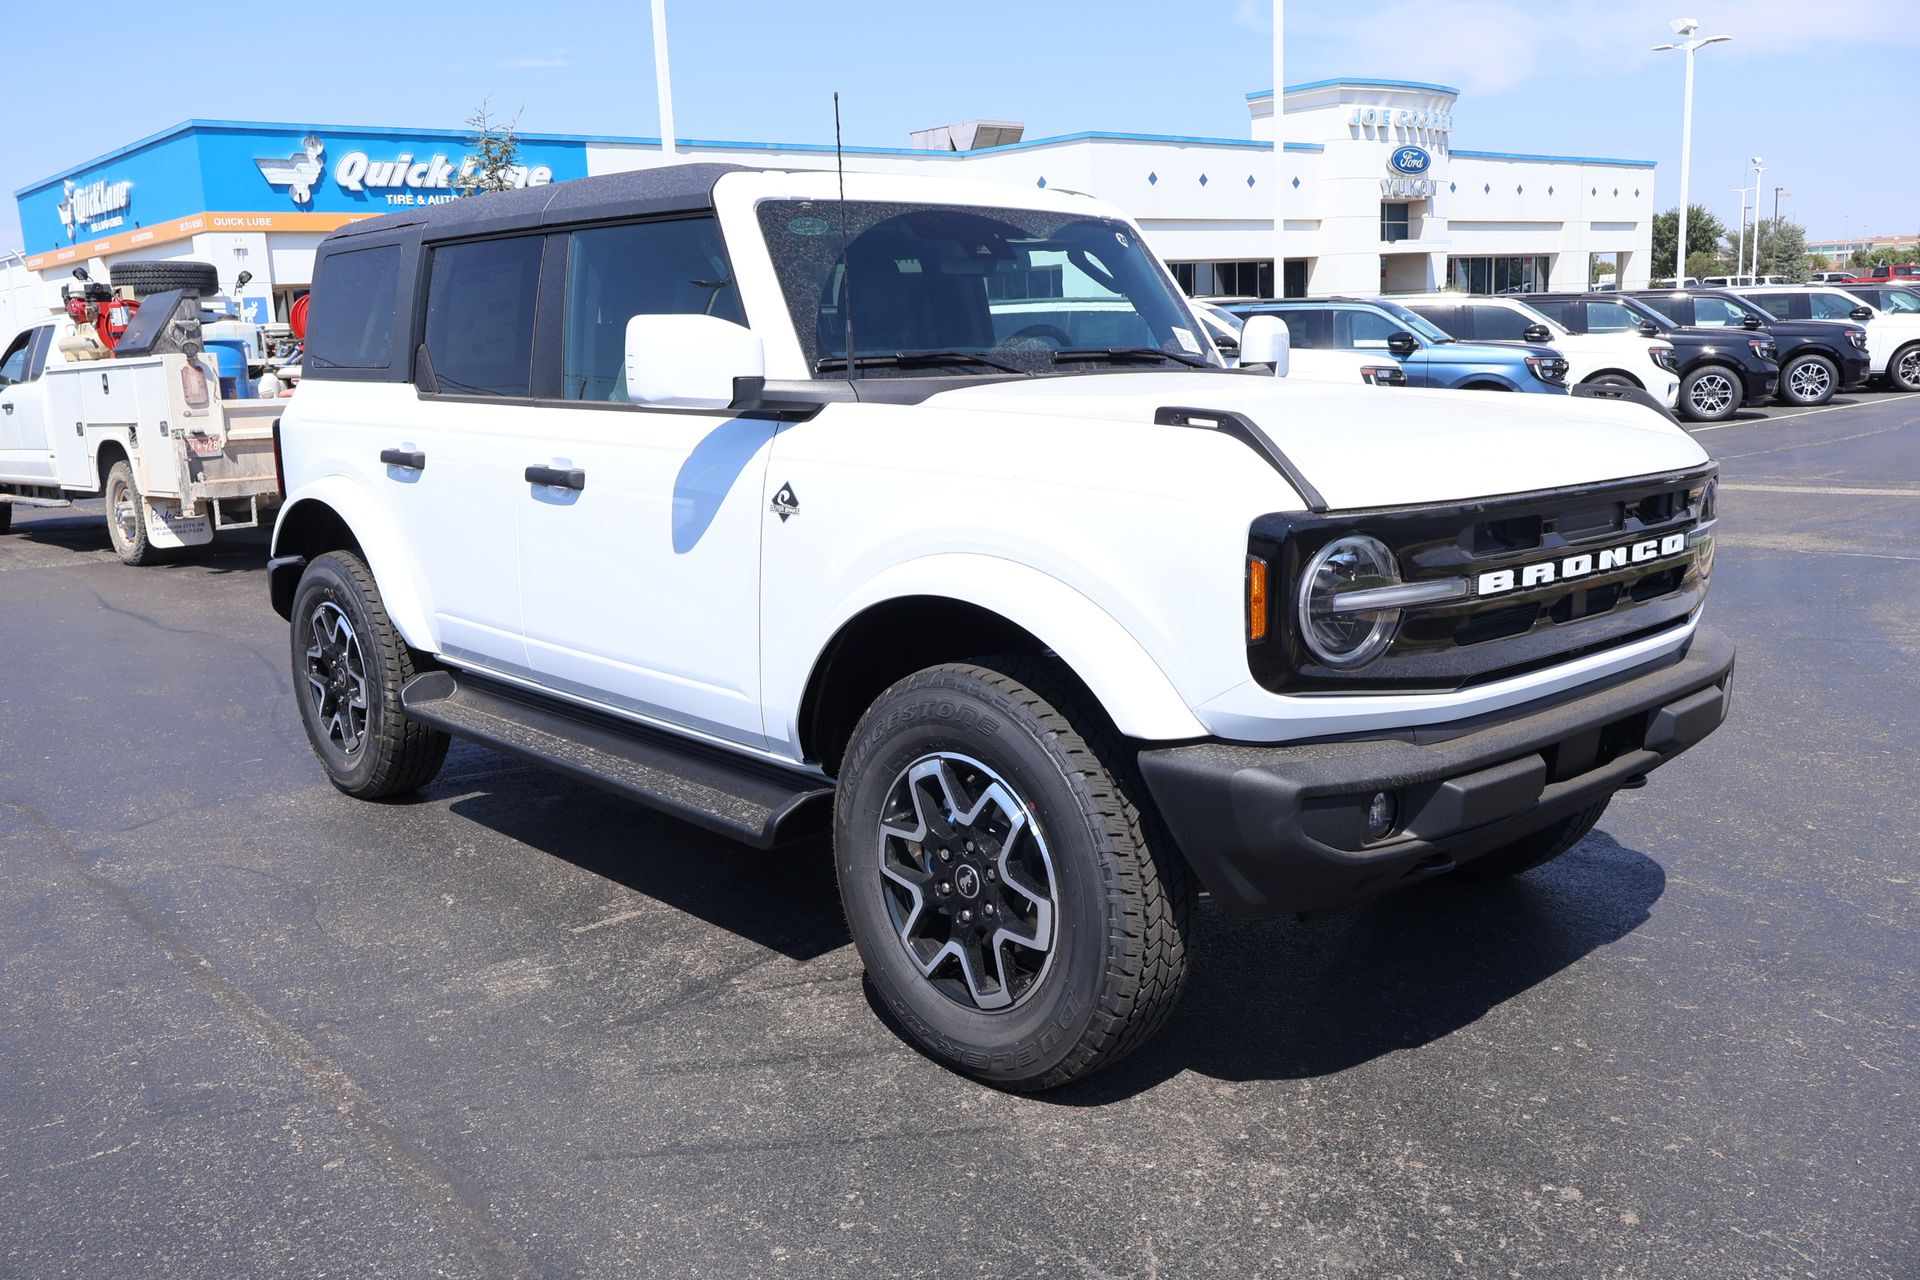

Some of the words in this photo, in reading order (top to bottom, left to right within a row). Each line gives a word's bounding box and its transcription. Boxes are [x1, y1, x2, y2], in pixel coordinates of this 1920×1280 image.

[1351, 107, 1391, 126] JOE
[1397, 110, 1454, 129] COOPER
[335, 151, 456, 192] Quick
[1400, 150, 1425, 169] Ford
[73, 182, 101, 224] Quick
[100, 180, 129, 213] Lane
[385, 194, 414, 205] TIRE
[417, 194, 426, 205] &
[1386, 179, 1437, 197] YUKON
[213, 217, 244, 226] QUICK
[246, 217, 273, 226] LUBE
[1478, 533, 1685, 596] BRONCO
[838, 700, 1000, 824] BRIDGESTONE
[938, 989, 1082, 1071] DUELER
